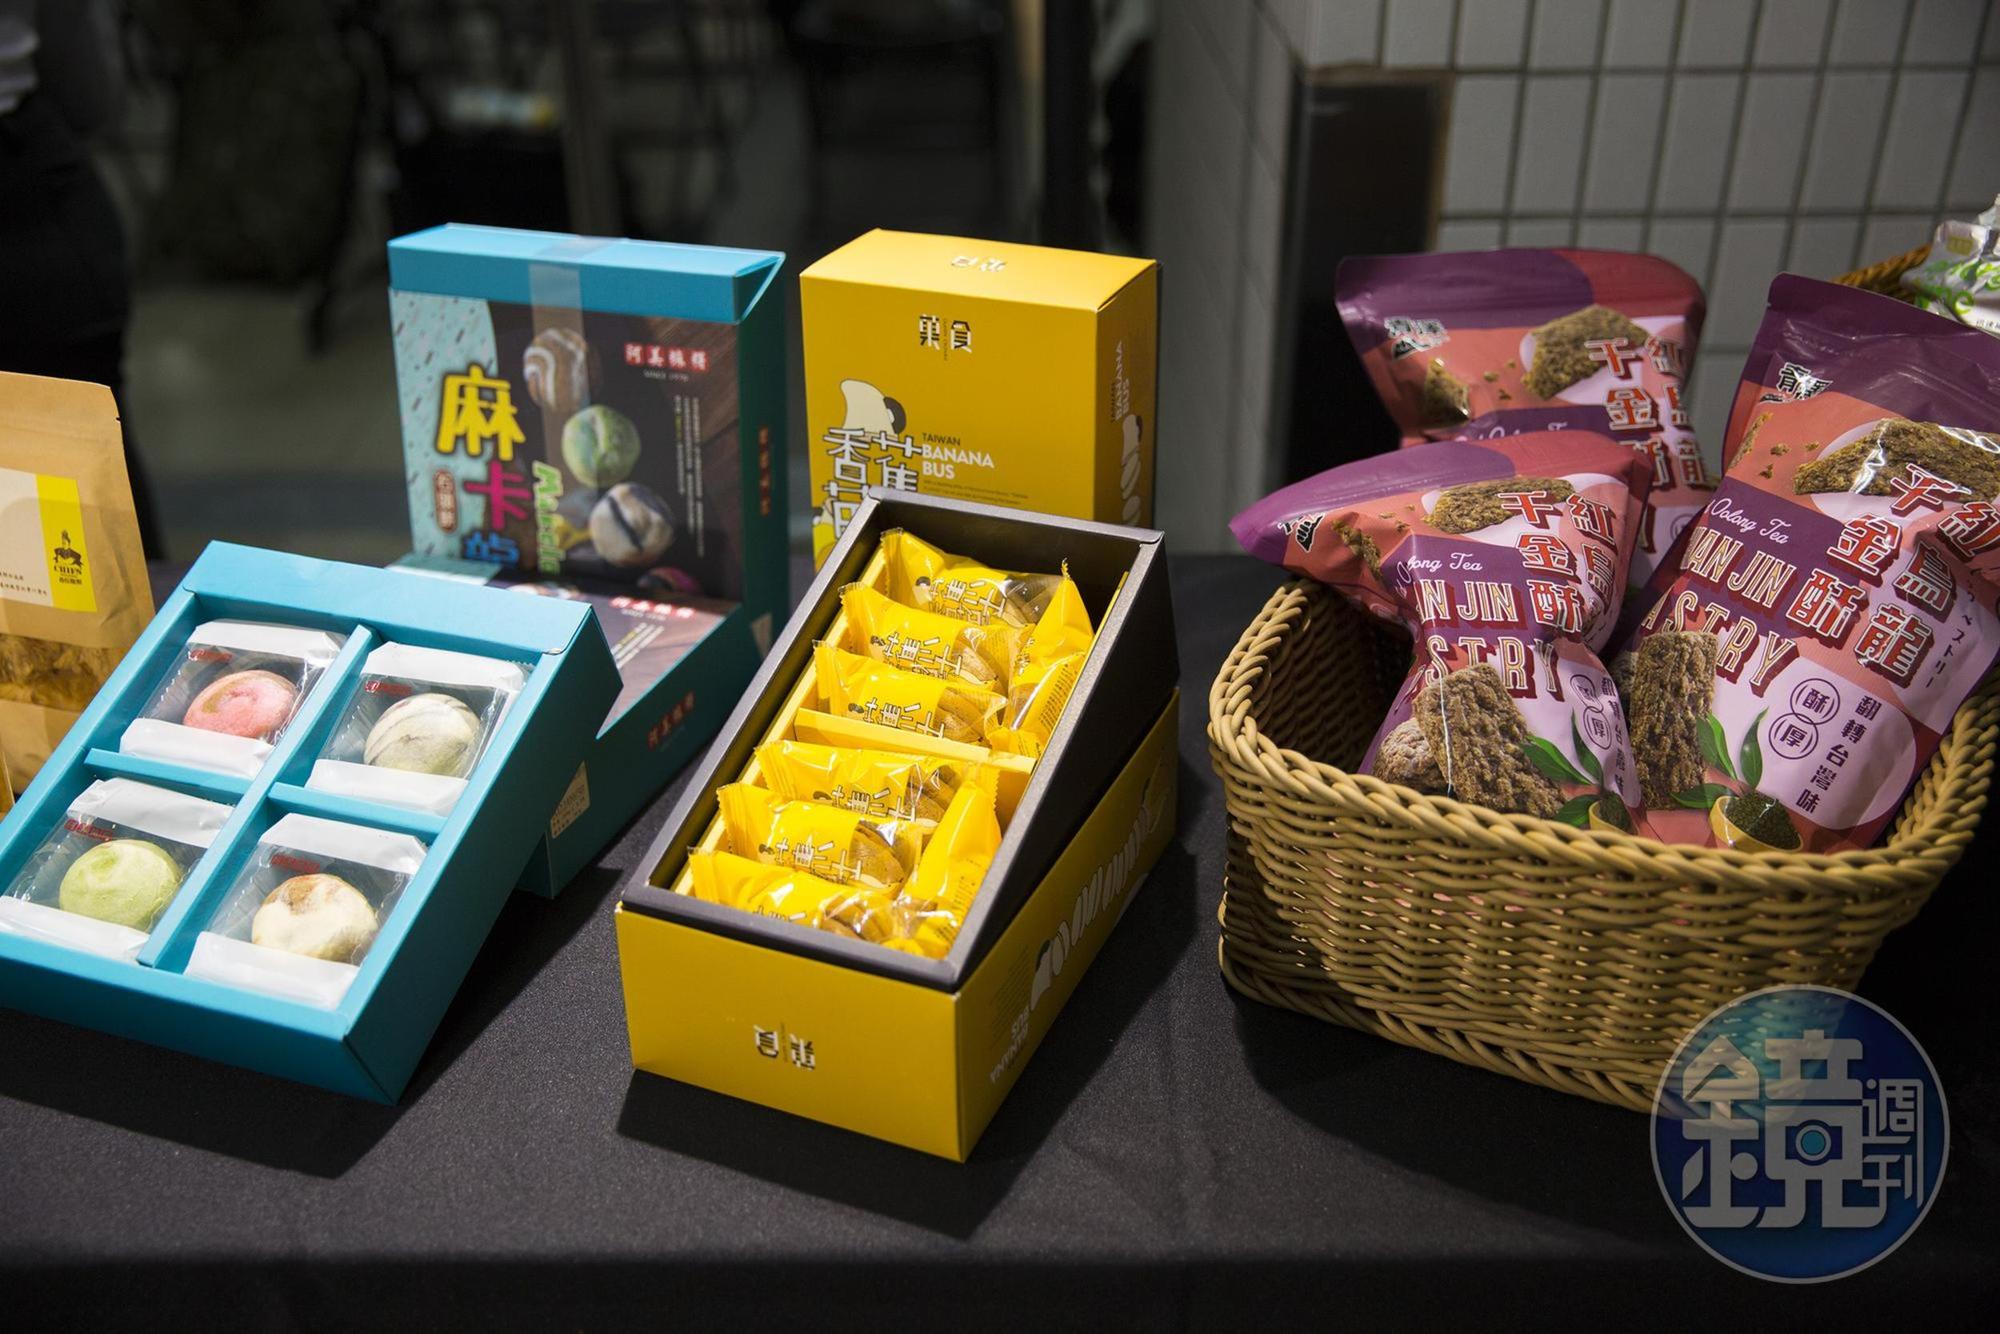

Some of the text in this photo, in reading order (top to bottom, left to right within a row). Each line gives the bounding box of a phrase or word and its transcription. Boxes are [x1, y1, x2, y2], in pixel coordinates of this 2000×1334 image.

[922, 444, 995, 469] BANANA
[923, 433, 961, 446] TAIWAN
[922, 462, 956, 480] BUS
[1711, 498, 1792, 544] Oolong Tea
[1449, 552, 1483, 572] Tea
[1727, 550, 1796, 609] JIN
[1456, 580, 1519, 623] JIN
[1795, 695, 1883, 814] 翻轉台灣味
